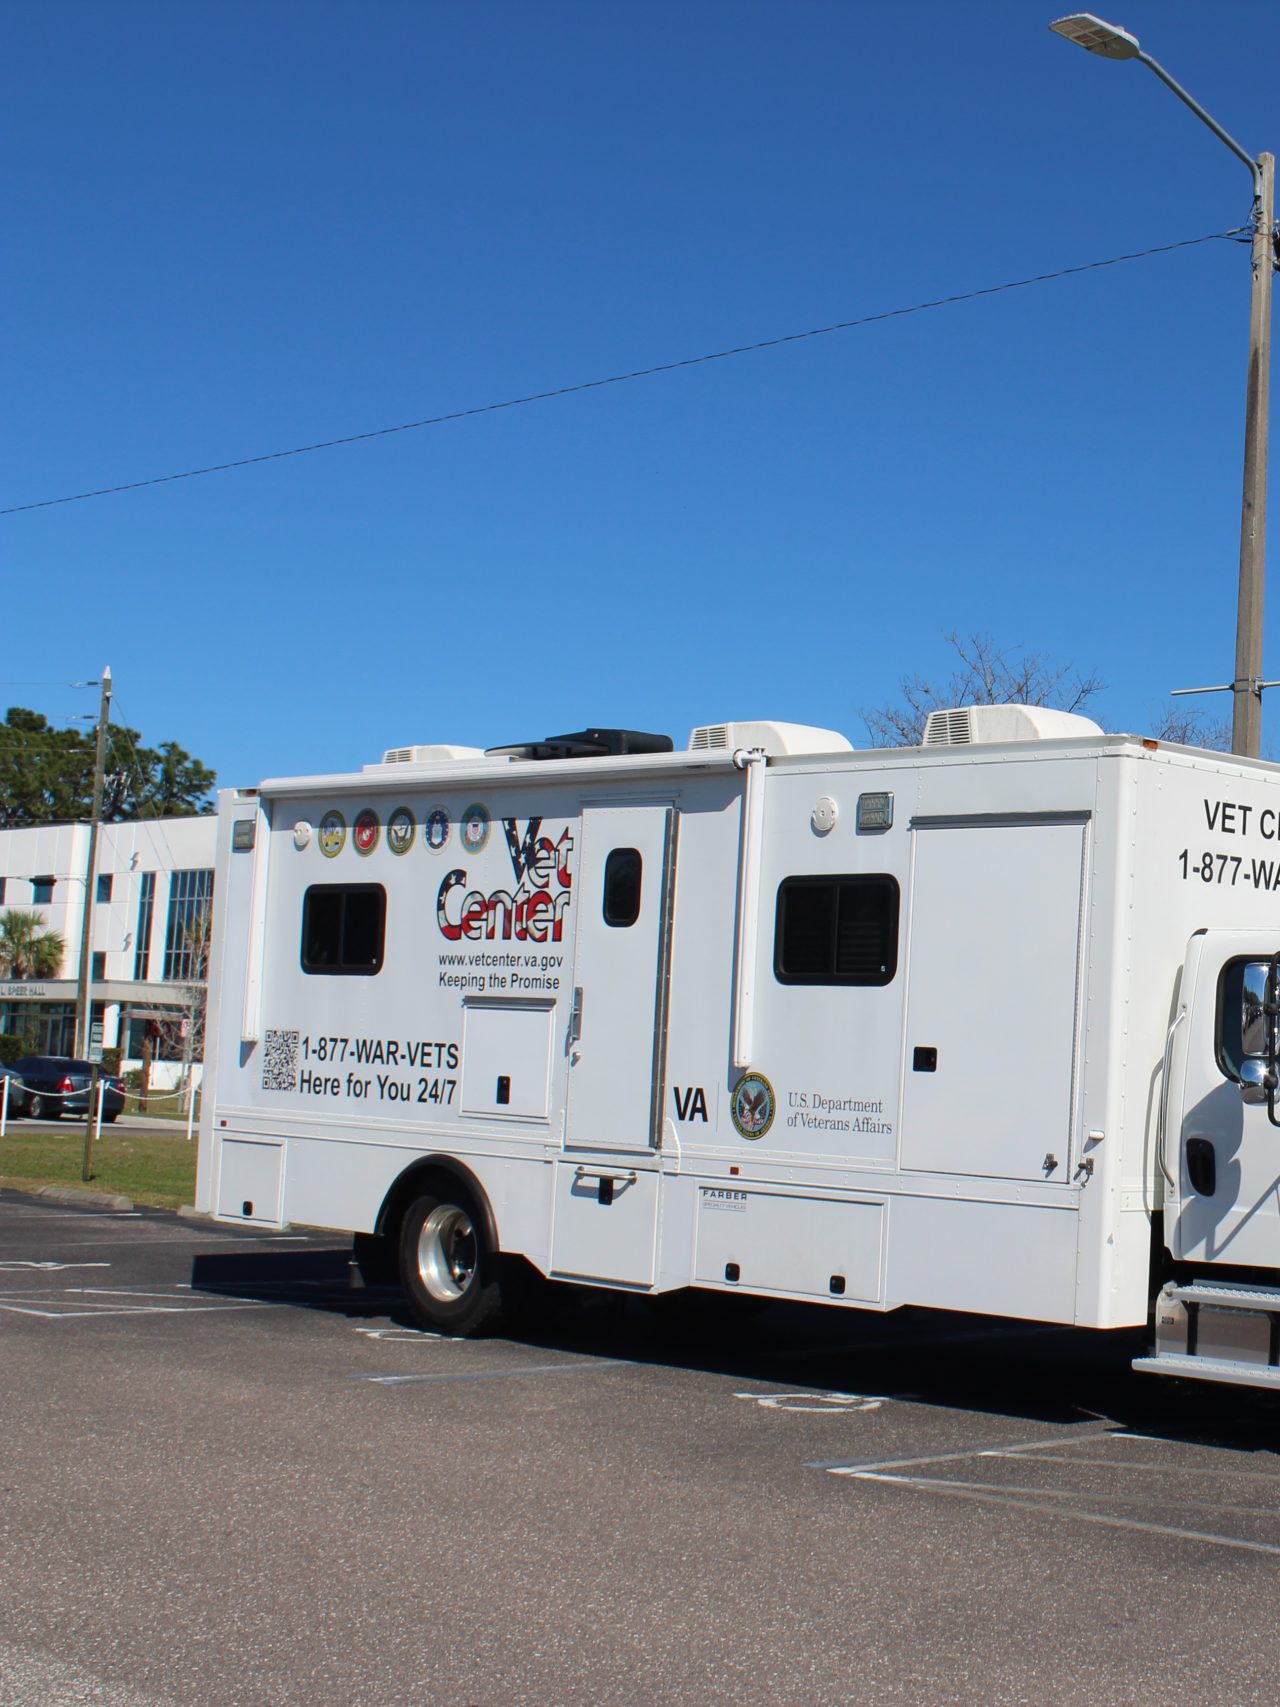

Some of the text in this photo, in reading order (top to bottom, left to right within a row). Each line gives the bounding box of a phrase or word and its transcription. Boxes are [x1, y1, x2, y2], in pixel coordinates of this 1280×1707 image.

[1203, 799, 1253, 836] VET
[501, 815, 574, 889] Vet
[436, 868, 571, 943] Center
[438, 953, 564, 971] www.vetcenter.va.gov
[438, 972, 560, 992] Keeping the Promise
[302, 1036, 459, 1070] 1-877-WAR-VETS
[300, 1069, 458, 1105] Here for You 24/7
[673, 1086, 709, 1122] VA
[788, 1092, 884, 1114] U.S. Department
[787, 1113, 893, 1135] of Veterans Affairs
[703, 1190, 747, 1200] FARBER
